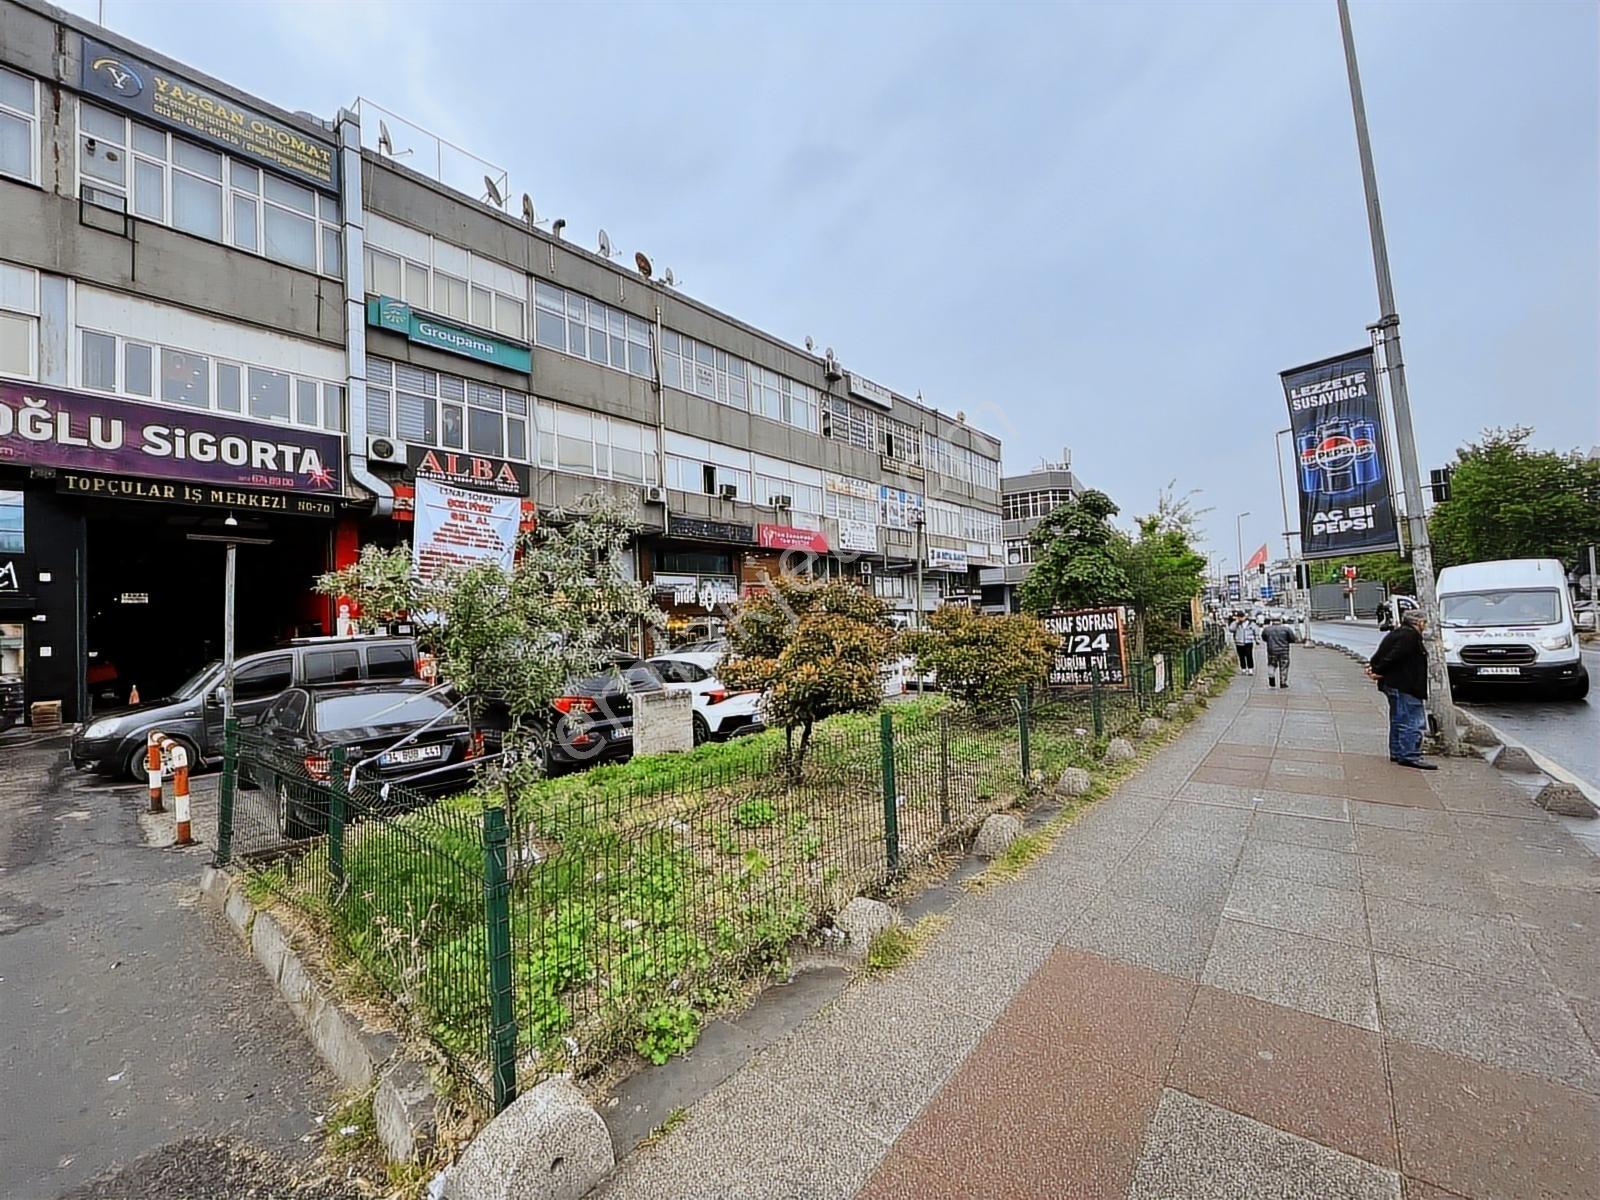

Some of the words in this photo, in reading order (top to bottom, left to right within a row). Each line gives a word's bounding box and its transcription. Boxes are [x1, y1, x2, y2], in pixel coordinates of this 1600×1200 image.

[154, 77, 244, 125] YAZGAN
[251, 121, 331, 162] OTOMAT
[419, 323, 494, 354] Groupama
[1291, 372, 1366, 399] LEZZETE
[1292, 383, 1368, 411] SUSAYINCA
[1317, 446, 1355, 460] PEPSI
[417, 450, 519, 485] ALBA
[65, 475, 176, 499] TOPÇULAR
[211, 490, 287, 509] MERKEZİ
[1312, 516, 1374, 536] PEPSI
[1045, 617, 1073, 633] ESNAF
[1075, 612, 1117, 632] SOFRASI
